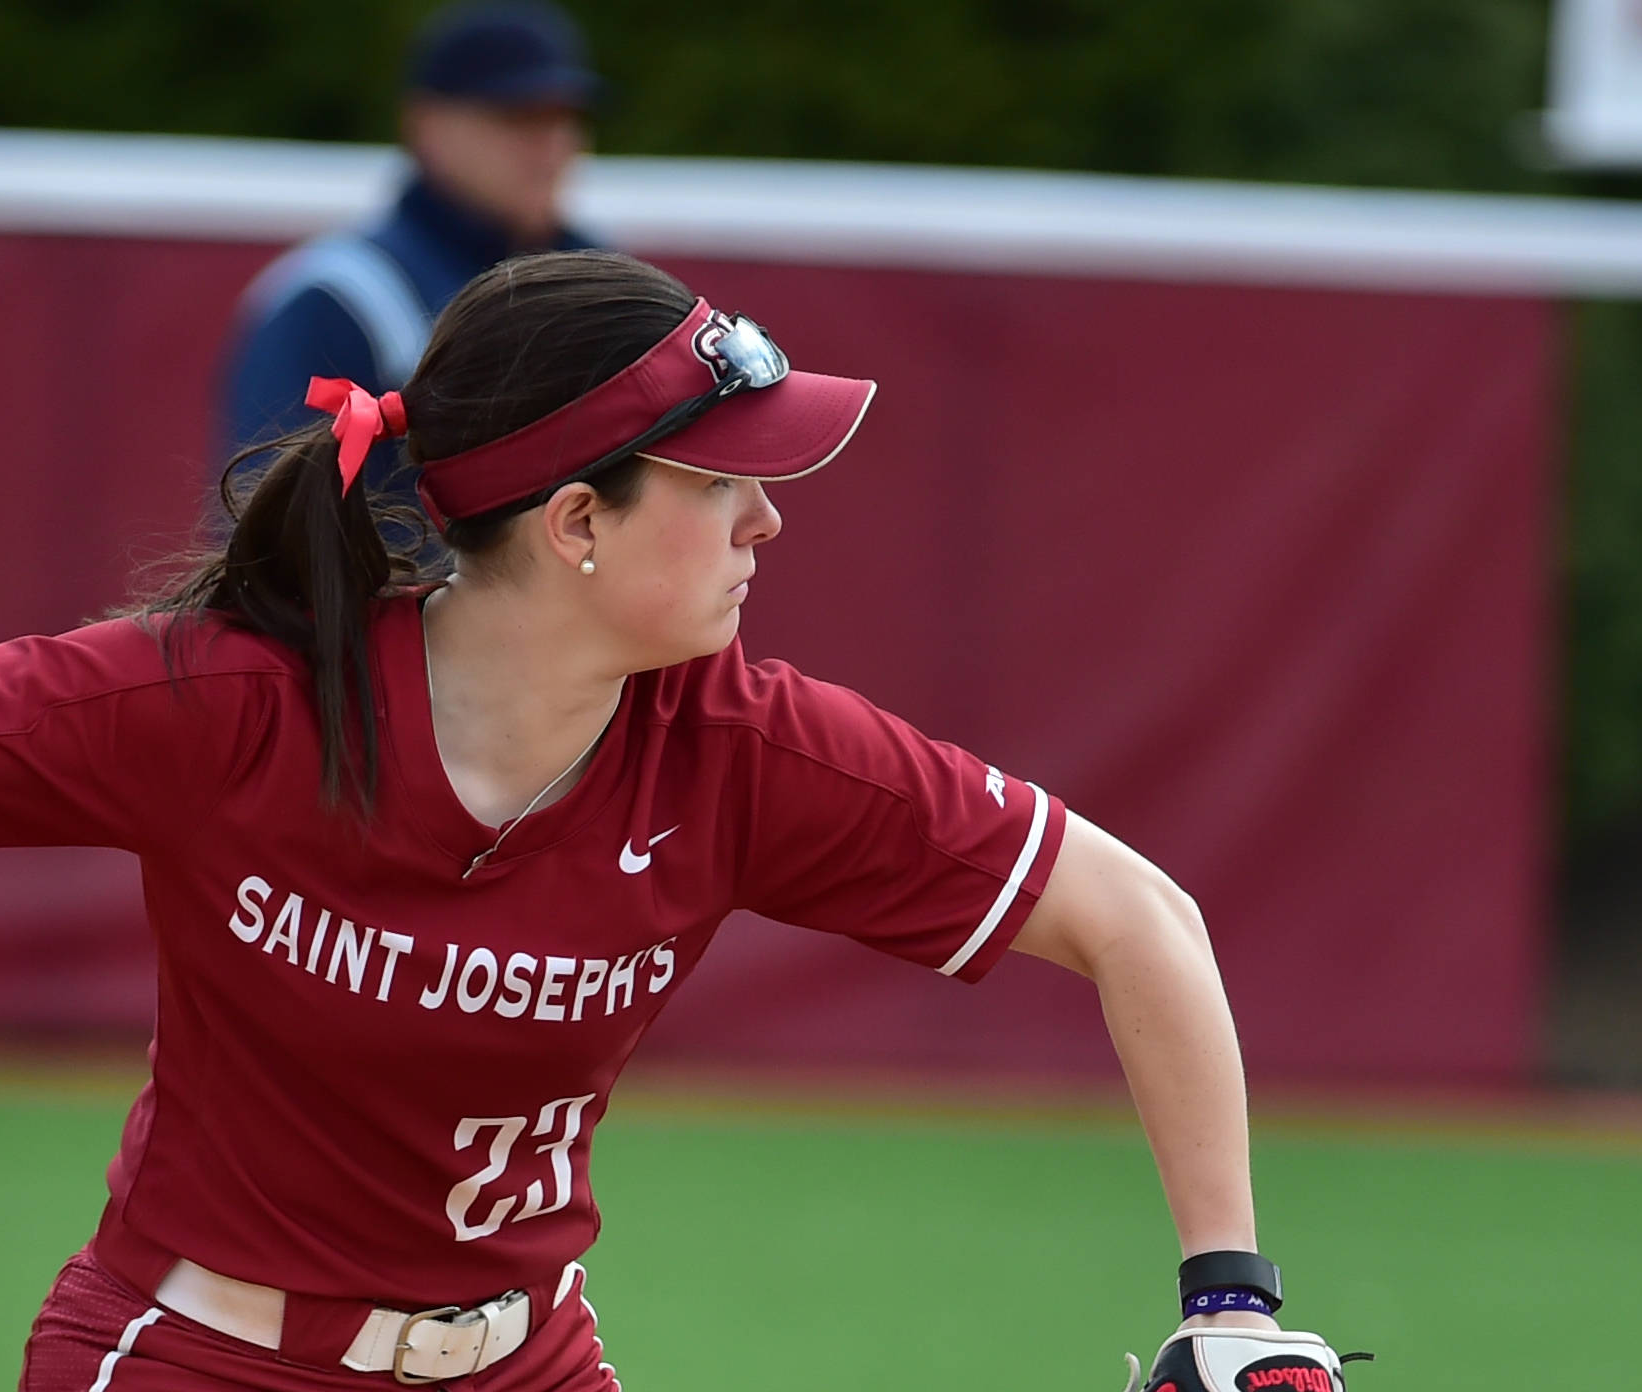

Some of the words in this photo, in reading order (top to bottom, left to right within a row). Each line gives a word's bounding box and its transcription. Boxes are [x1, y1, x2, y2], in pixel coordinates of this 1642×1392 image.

[227, 874, 415, 1003] SAINT
[418, 935, 678, 1022] JOSEPH'S
[444, 1092, 597, 1242] 23
